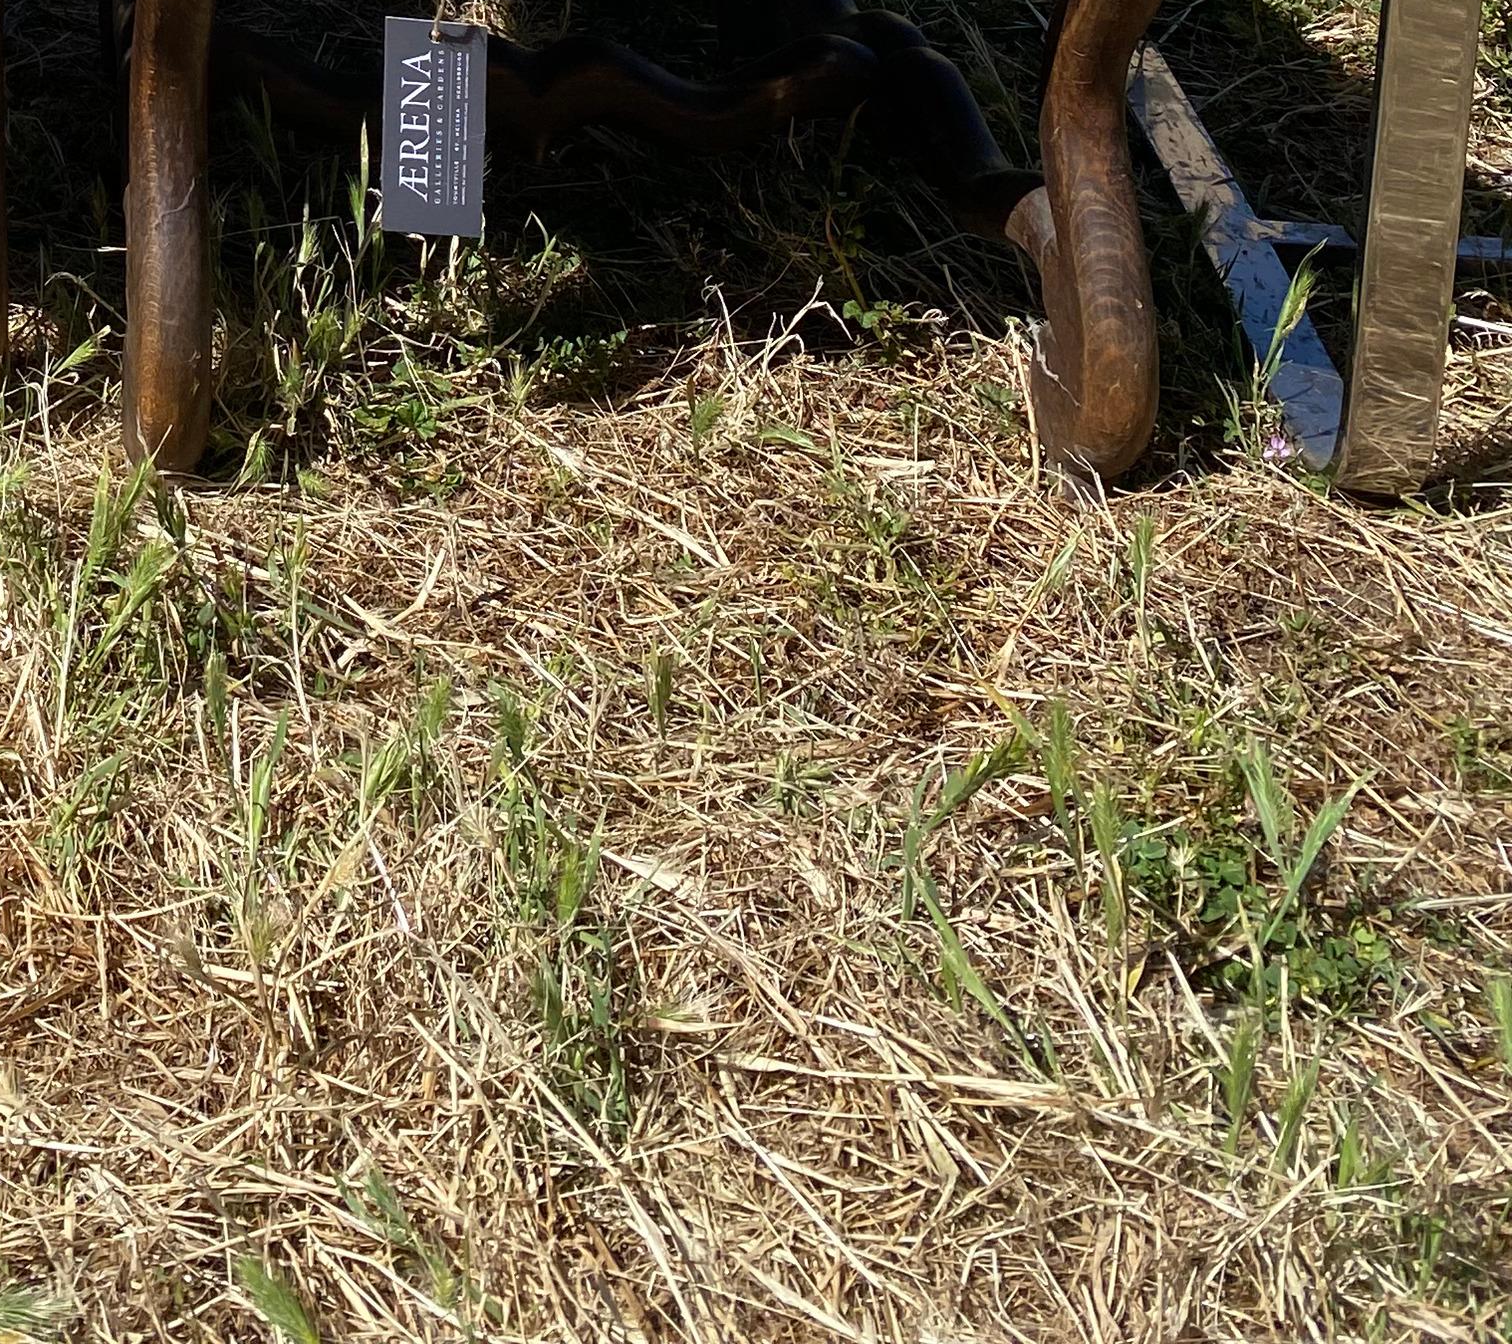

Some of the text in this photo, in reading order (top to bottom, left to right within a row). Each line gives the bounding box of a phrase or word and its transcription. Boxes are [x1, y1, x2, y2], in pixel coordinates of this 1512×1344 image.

[435, 49, 445, 111] GARDENS
[398, 50, 432, 204] ÆRENA
[433, 130, 443, 205] GALLERIES
